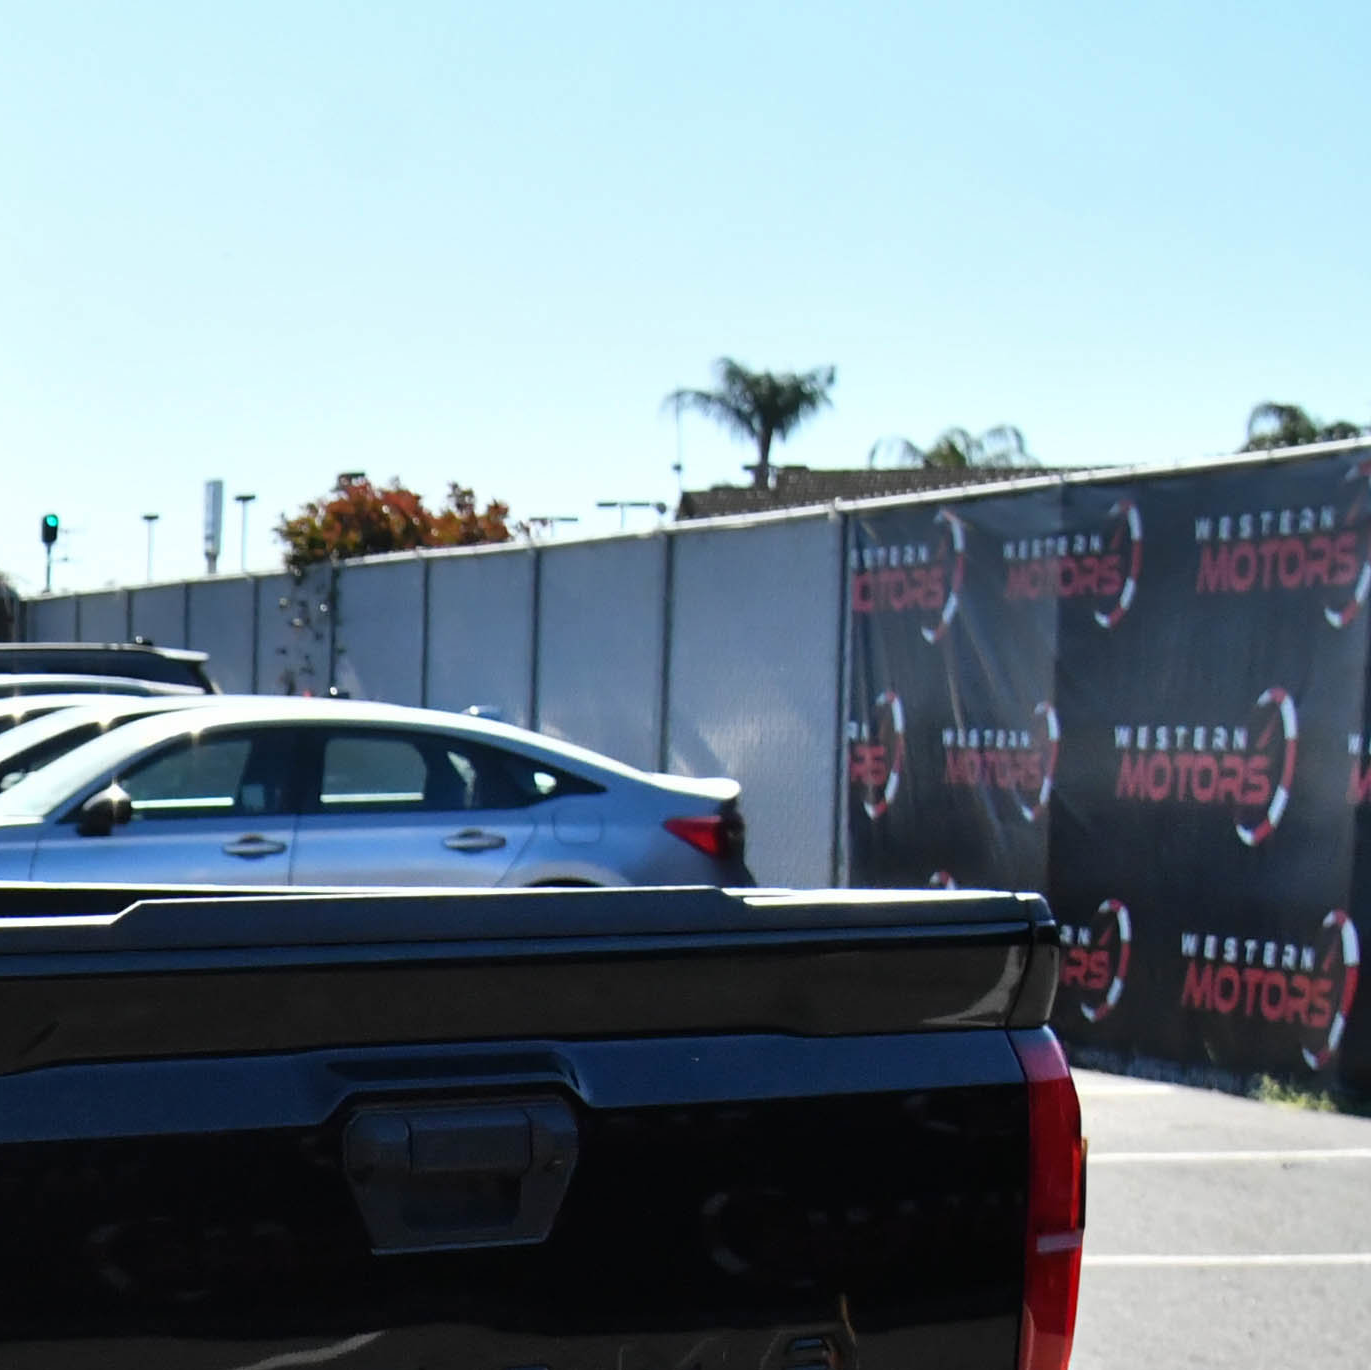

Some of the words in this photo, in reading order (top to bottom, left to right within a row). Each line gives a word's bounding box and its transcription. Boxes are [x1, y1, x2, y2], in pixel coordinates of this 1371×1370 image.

[1195, 505, 1335, 543] WESTERN
[851, 543, 929, 568] ESTERN
[1004, 553, 1122, 599] MOTORS
[1196, 531, 1358, 593] MOTORS
[852, 566, 944, 613] OTORS
[1114, 724, 1248, 751] WESTERN
[1116, 751, 1271, 805] MOTORS
[1181, 930, 1315, 972] WESTERN
[1180, 959, 1333, 1028] MOTORS
